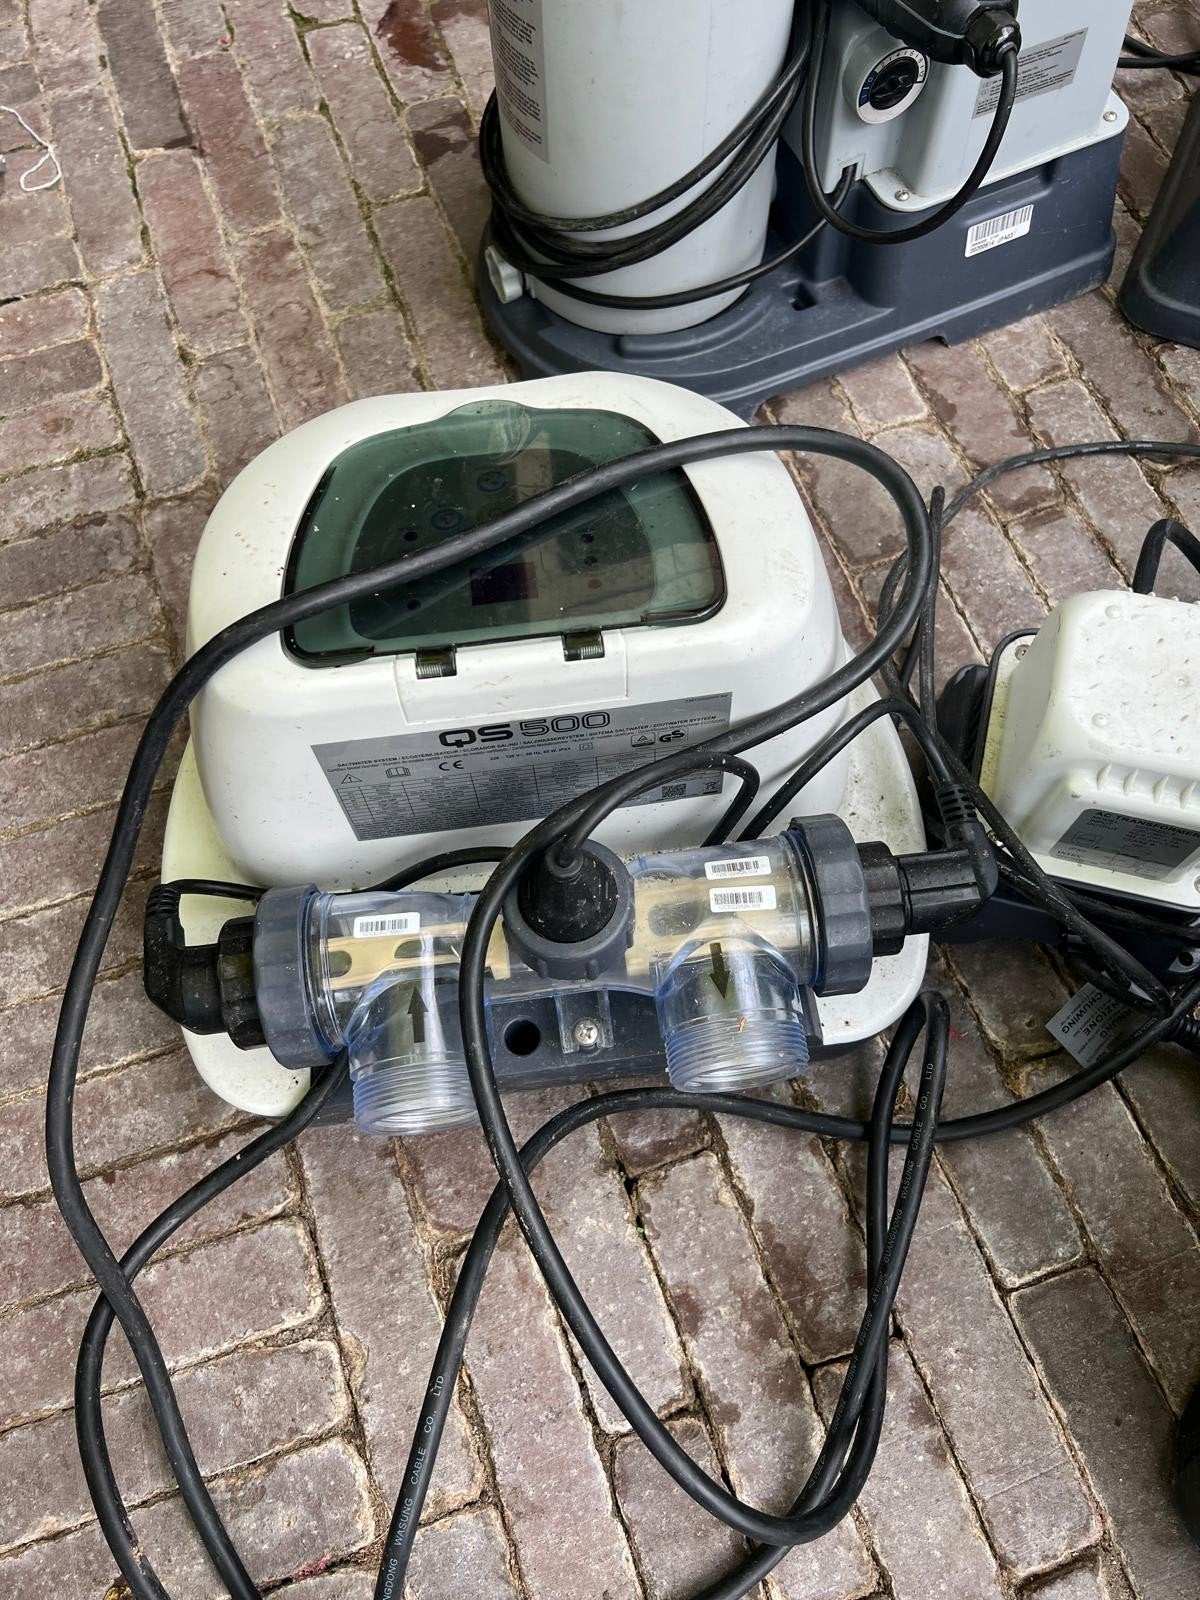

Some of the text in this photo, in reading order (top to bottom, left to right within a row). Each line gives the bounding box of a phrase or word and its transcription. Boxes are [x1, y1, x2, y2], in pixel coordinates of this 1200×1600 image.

[337, 759, 373, 768] SALTWATER
[614, 724, 649, 733] SALTWATER
[439, 723, 514, 748] QS
[519, 711, 611, 737] 500
[659, 730, 685, 742] GS
[883, 1208, 903, 1264] GUANGDONG
[900, 1159, 915, 1199] WASUNG
[911, 1120, 923, 1150] CABLE
[926, 1062, 934, 1080] LTD
[394, 1497, 414, 1546] WASUNG
[410, 1448, 427, 1485] CABLE
[424, 1410, 437, 1433] CO.,
[434, 1374, 445, 1397] LTD
